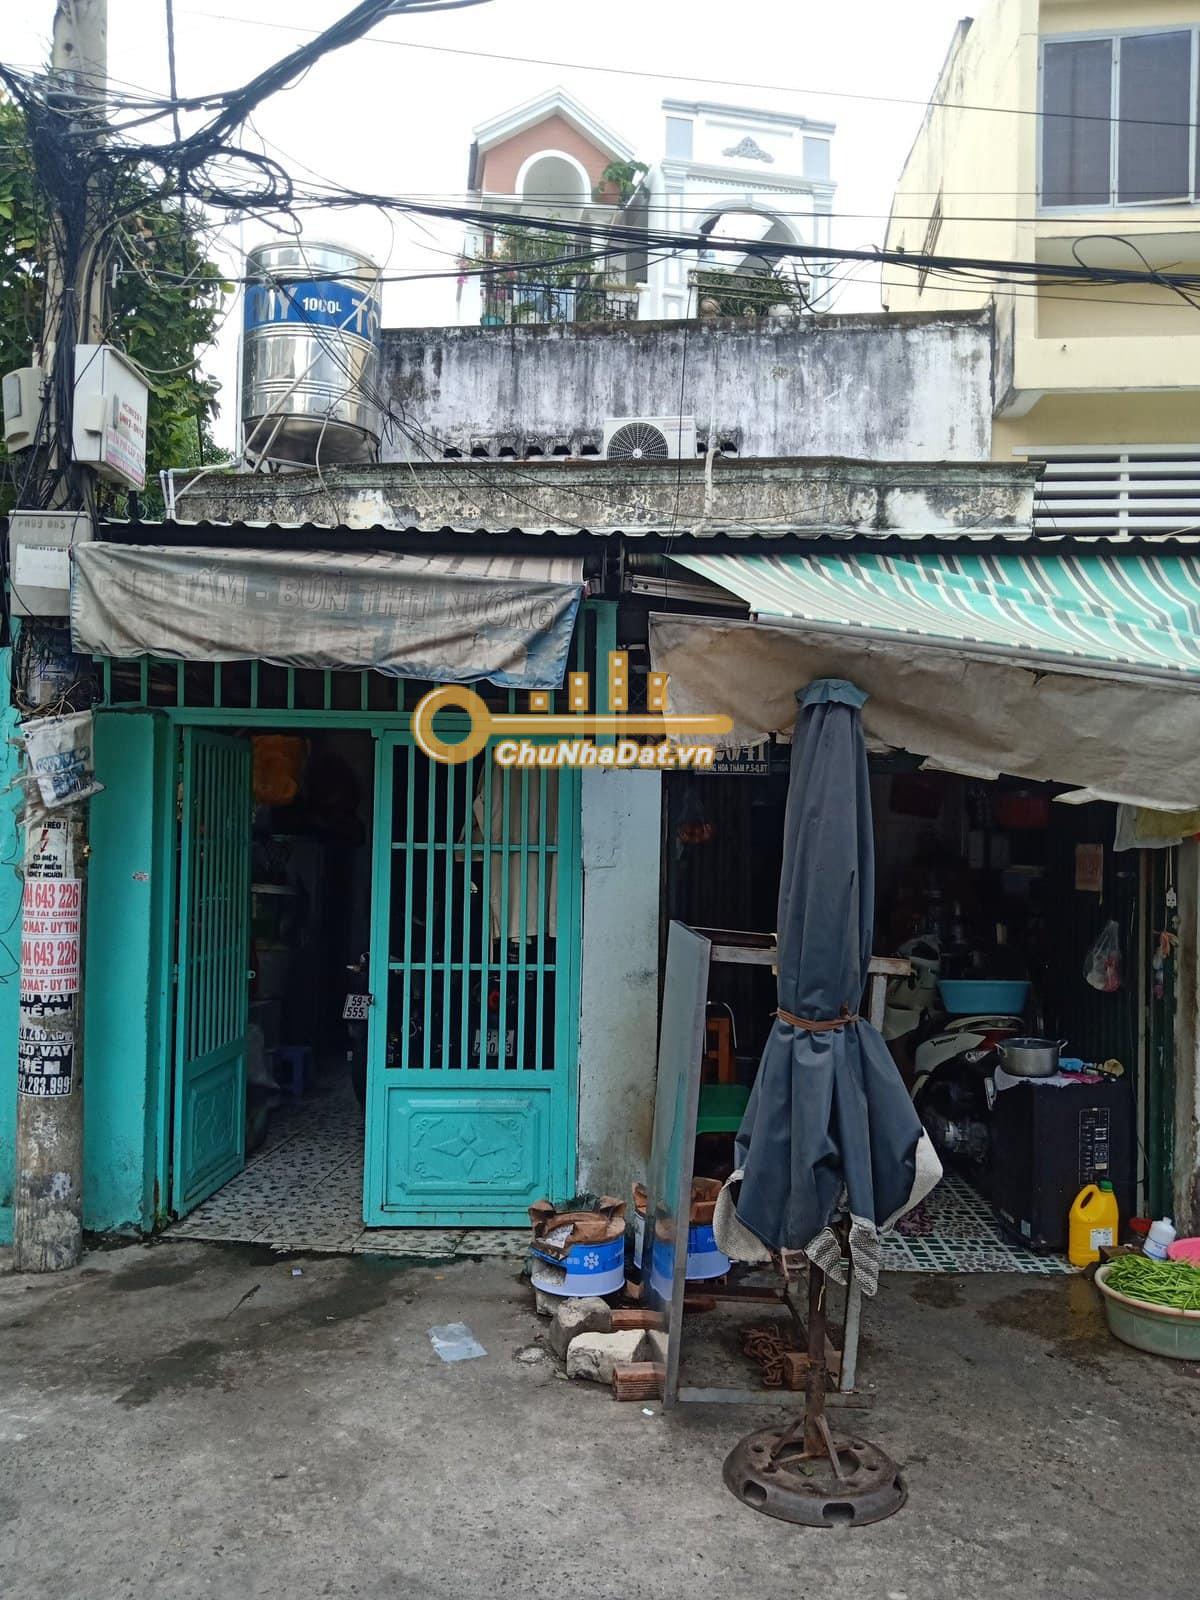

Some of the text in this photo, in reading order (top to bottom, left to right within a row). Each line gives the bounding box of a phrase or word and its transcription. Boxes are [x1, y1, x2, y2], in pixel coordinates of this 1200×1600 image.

[303, 297, 342, 314] 1000L
[35, 883, 55, 909] 643
[59, 883, 78, 909] 226
[34, 941, 54, 967] 643
[58, 940, 77, 966] 226
[41, 1045, 71, 1057] VAY
